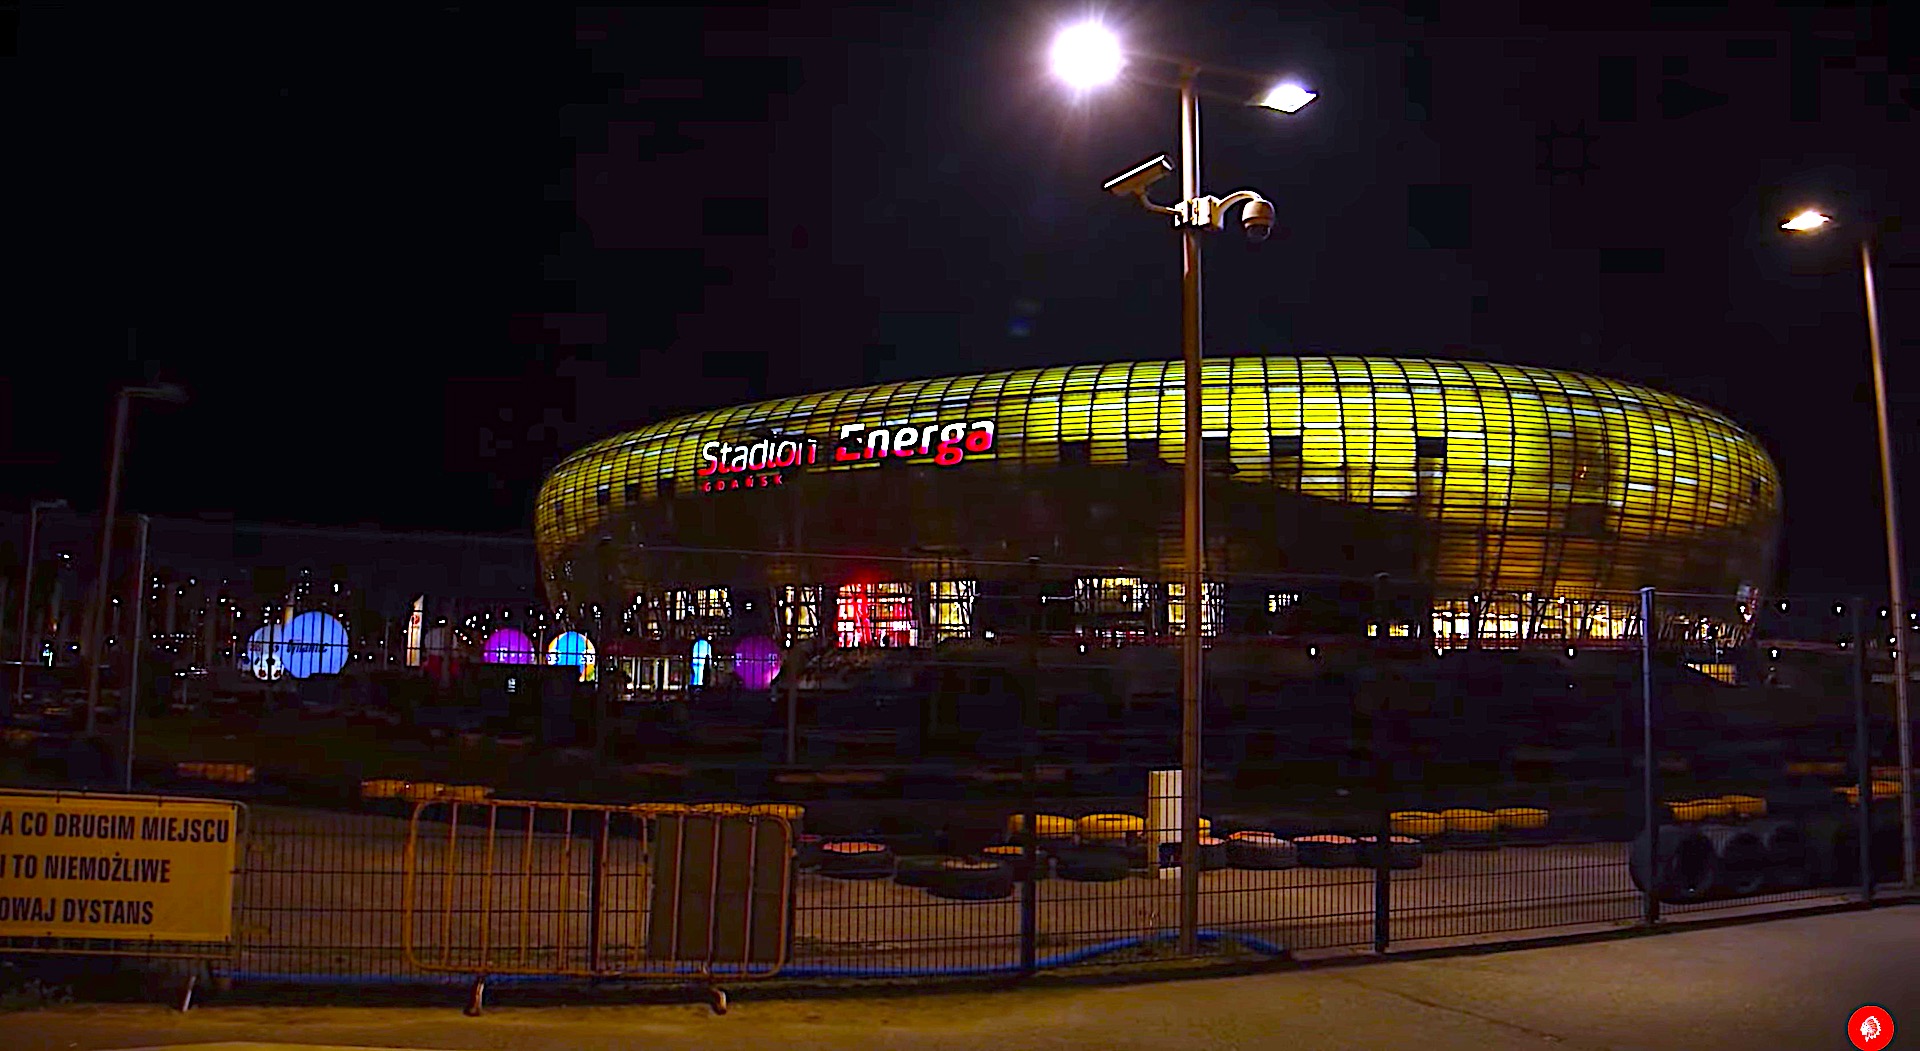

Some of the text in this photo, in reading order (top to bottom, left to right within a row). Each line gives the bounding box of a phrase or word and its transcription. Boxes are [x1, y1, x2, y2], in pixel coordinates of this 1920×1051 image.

[697, 420, 995, 477] Stadion Energa
[20, 812, 48, 837] CO
[54, 813, 136, 840] DRUGIM
[141, 816, 229, 843] MIEJSCU
[13, 855, 37, 879] TO
[44, 851, 171, 883] NIEMOŻLIWE
[63, 898, 154, 925] DYSTANS
